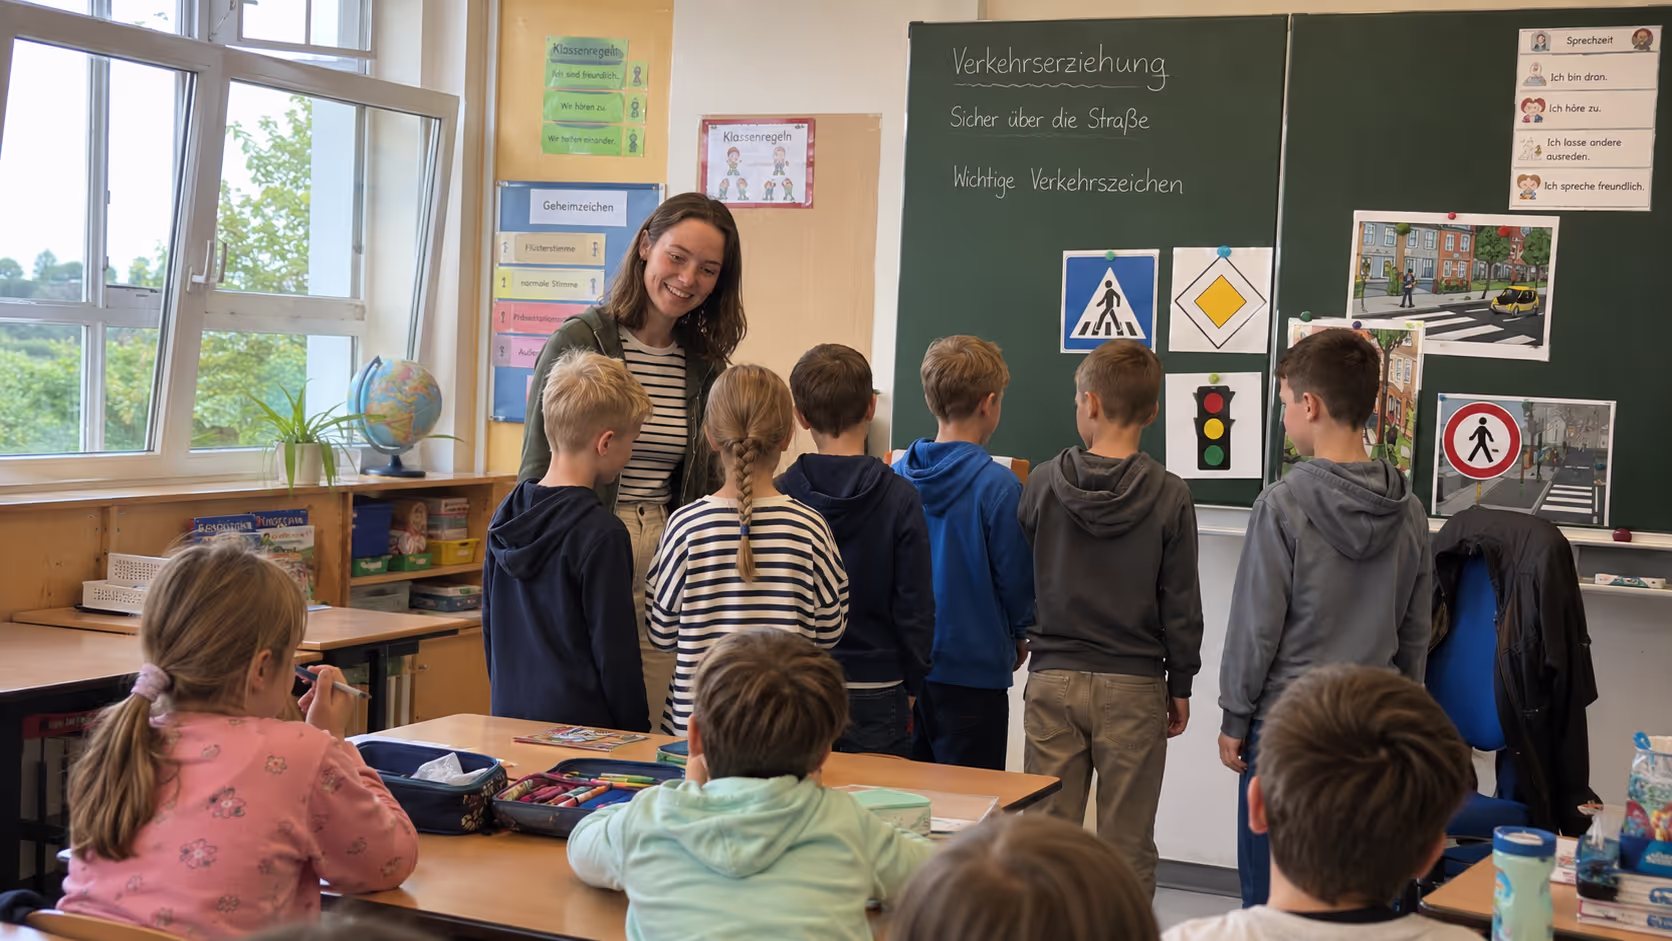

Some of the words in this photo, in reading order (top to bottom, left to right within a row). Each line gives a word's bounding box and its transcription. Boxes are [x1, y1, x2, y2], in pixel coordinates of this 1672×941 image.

[1566, 35, 1613, 46] Sprechzeit
[953, 43, 1168, 92] Verkehrserziehung
[1550, 73, 1565, 82] Ich
[1567, 72, 1582, 82] bin
[1584, 71, 1608, 82] dran.
[1549, 104, 1563, 113] Ich
[1565, 103, 1586, 113] höre
[1588, 105, 1602, 113] zu.
[950, 105, 999, 128] Sicher
[1008, 106, 1044, 129] über
[1052, 107, 1078, 129] die
[1087, 107, 1150, 136] Straße
[723, 130, 792, 145] Klassenregeln
[1547, 138, 1561, 147] Ich
[1564, 138, 1587, 147] lasse
[1589, 139, 1622, 147] andere
[1546, 152, 1591, 161] ausreden.
[953, 165, 1016, 199] Wichtige
[1030, 167, 1184, 194] Verkehrszeichen
[1544, 181, 1558, 190] Ich
[1560, 181, 1596, 192] spreche
[1597, 180, 1645, 192] freundlich.
[543, 201, 614, 213] Geheimzeichen
[551, 280, 578, 289] Stimme
